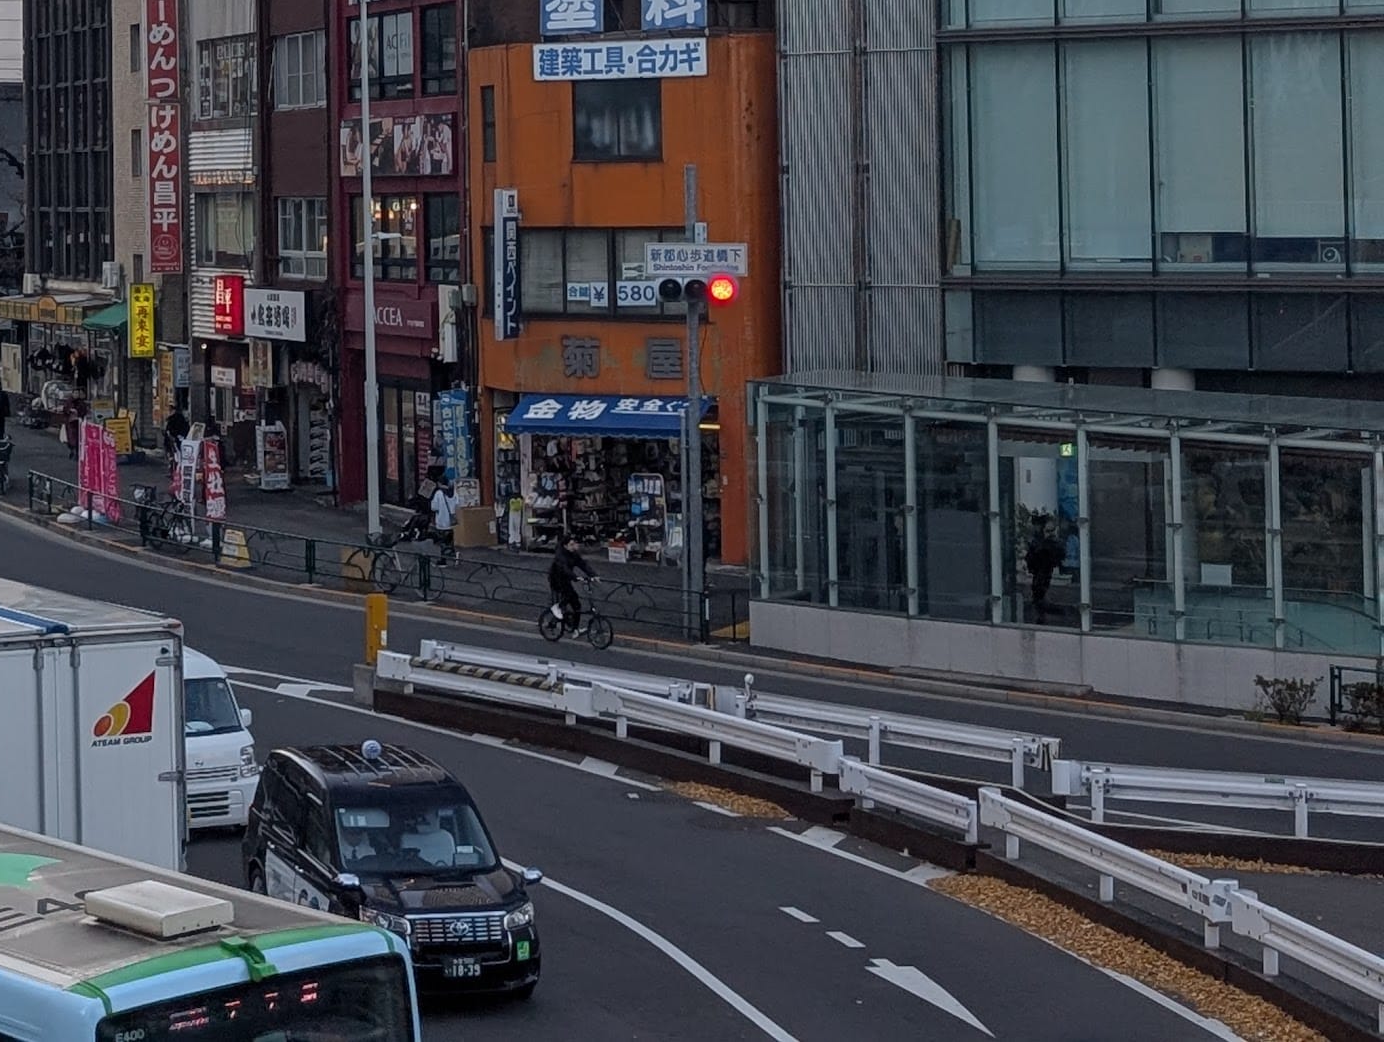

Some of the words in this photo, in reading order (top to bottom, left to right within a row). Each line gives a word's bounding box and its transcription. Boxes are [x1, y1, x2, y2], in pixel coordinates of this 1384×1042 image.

[539, 42, 701, 77] 建築工具・合カギ
[650, 248, 742, 263] 新都心歩道橋下
[593, 286, 605, 302] ¥
[618, 285, 655, 302] 580
[523, 398, 607, 420] 金物
[91, 738, 121, 748] ATEAM
[123, 735, 152, 745] GROUP
